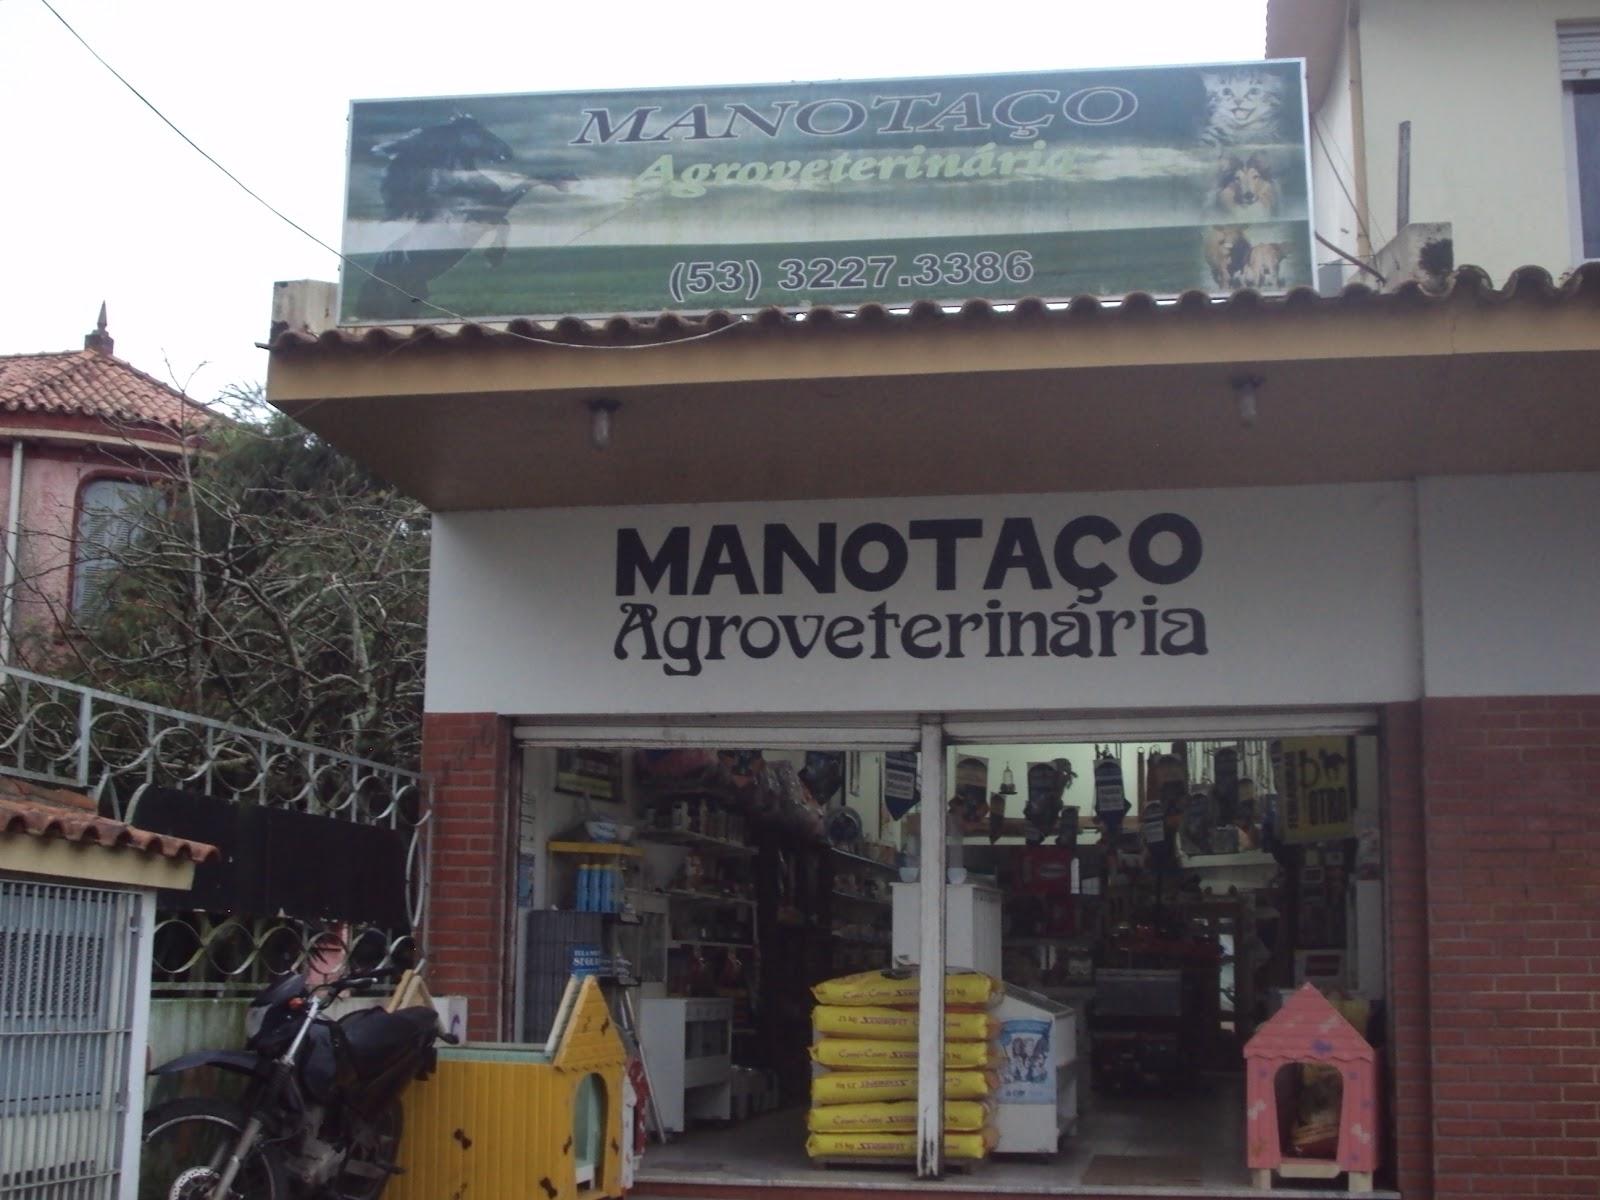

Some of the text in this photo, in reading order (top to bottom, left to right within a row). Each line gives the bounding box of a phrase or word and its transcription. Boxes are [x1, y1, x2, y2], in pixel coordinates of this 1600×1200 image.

[568, 86, 1139, 146] MANOTAÇO
[630, 139, 1077, 199] Agroveterinária
[669, 250, 1034, 303] (53) 3227.3386
[615, 512, 1203, 604] MANOTAÇO
[613, 595, 1209, 676] Agroveterinária
